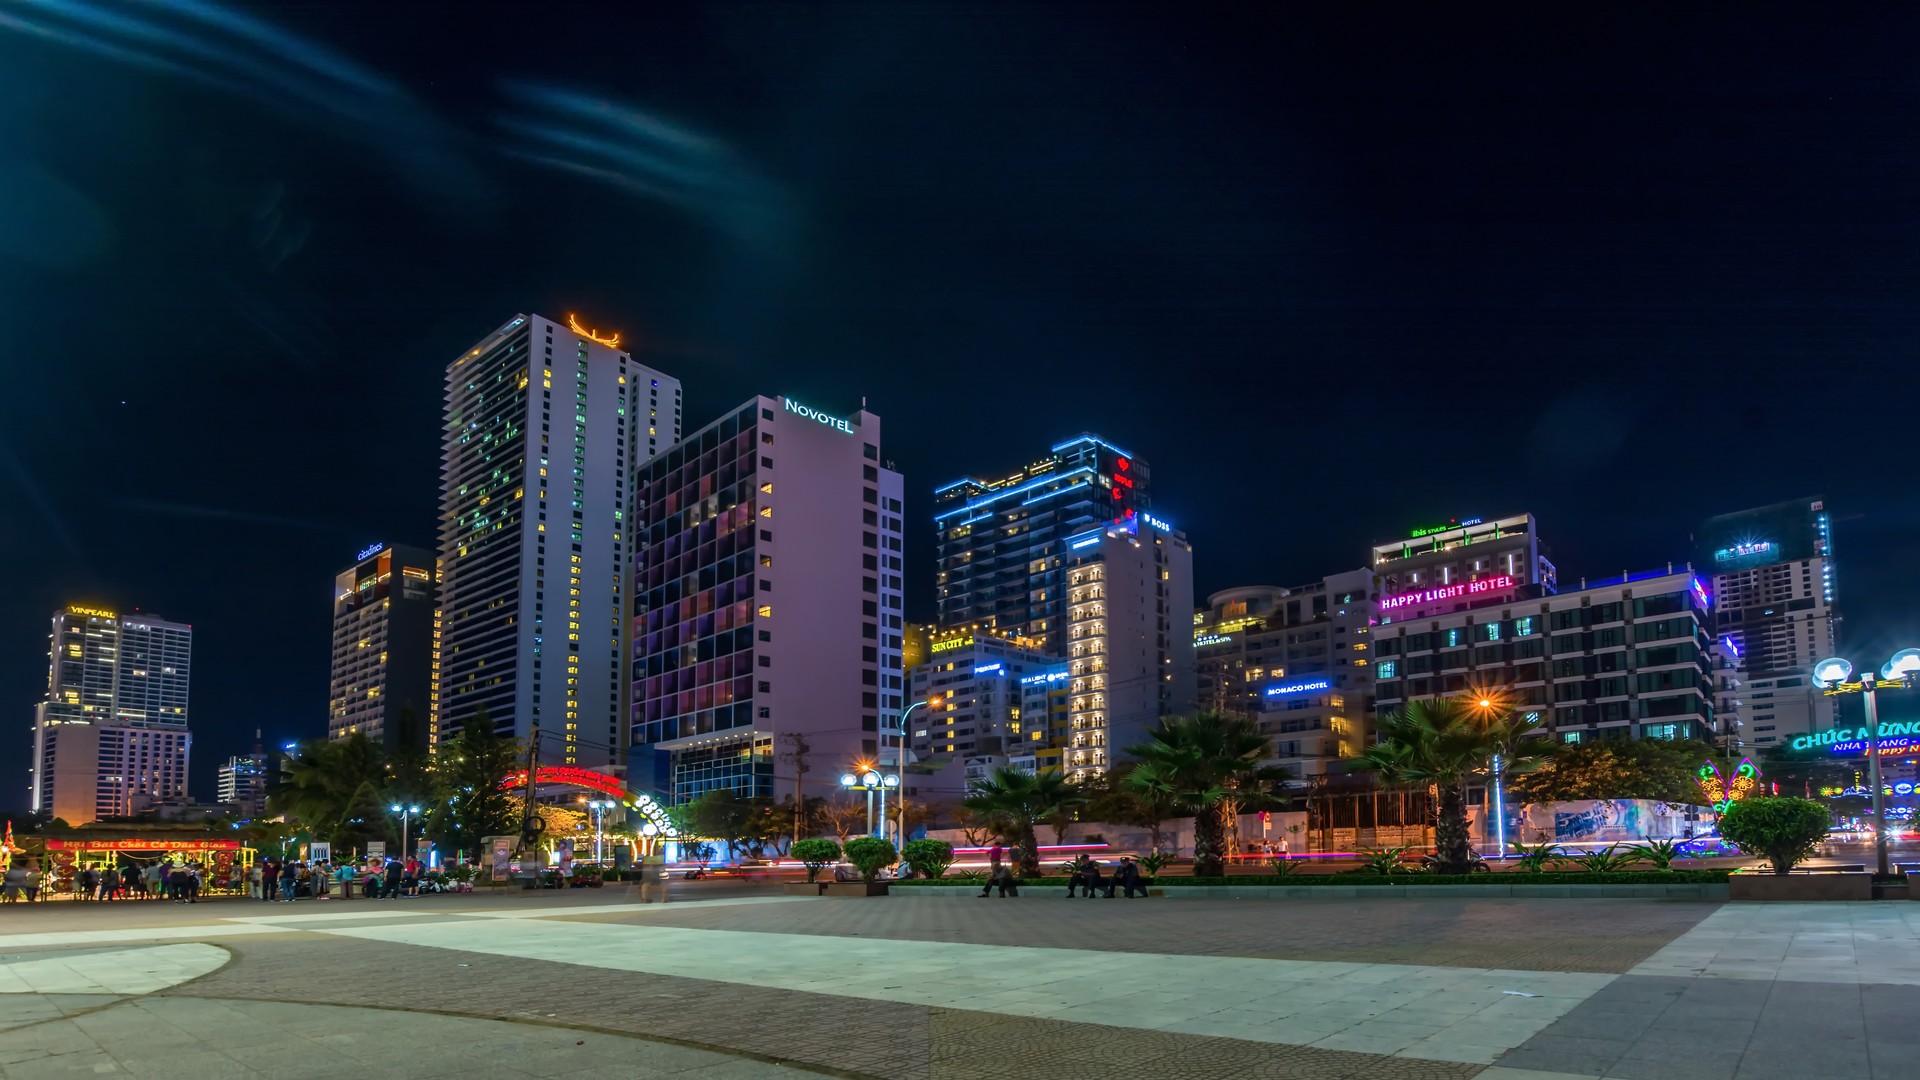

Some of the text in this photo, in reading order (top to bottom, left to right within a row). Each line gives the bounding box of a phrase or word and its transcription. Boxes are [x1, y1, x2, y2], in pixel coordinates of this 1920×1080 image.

[785, 398, 854, 434] NOVOTEL
[1151, 517, 1170, 531] BOSS
[1412, 529, 1427, 537] ibis
[1462, 518, 1482, 527] HOTEL
[1382, 576, 1513, 609] HAPPY LIGHT HOTEL
[71, 605, 116, 619] VINPEARL
[931, 641, 946, 653] SUN
[946, 637, 964, 649] CITY
[1268, 681, 1328, 695] MONACO HOTEL
[1792, 729, 1852, 750] CHÚC
[1833, 738, 1909, 751] NHA TANG
